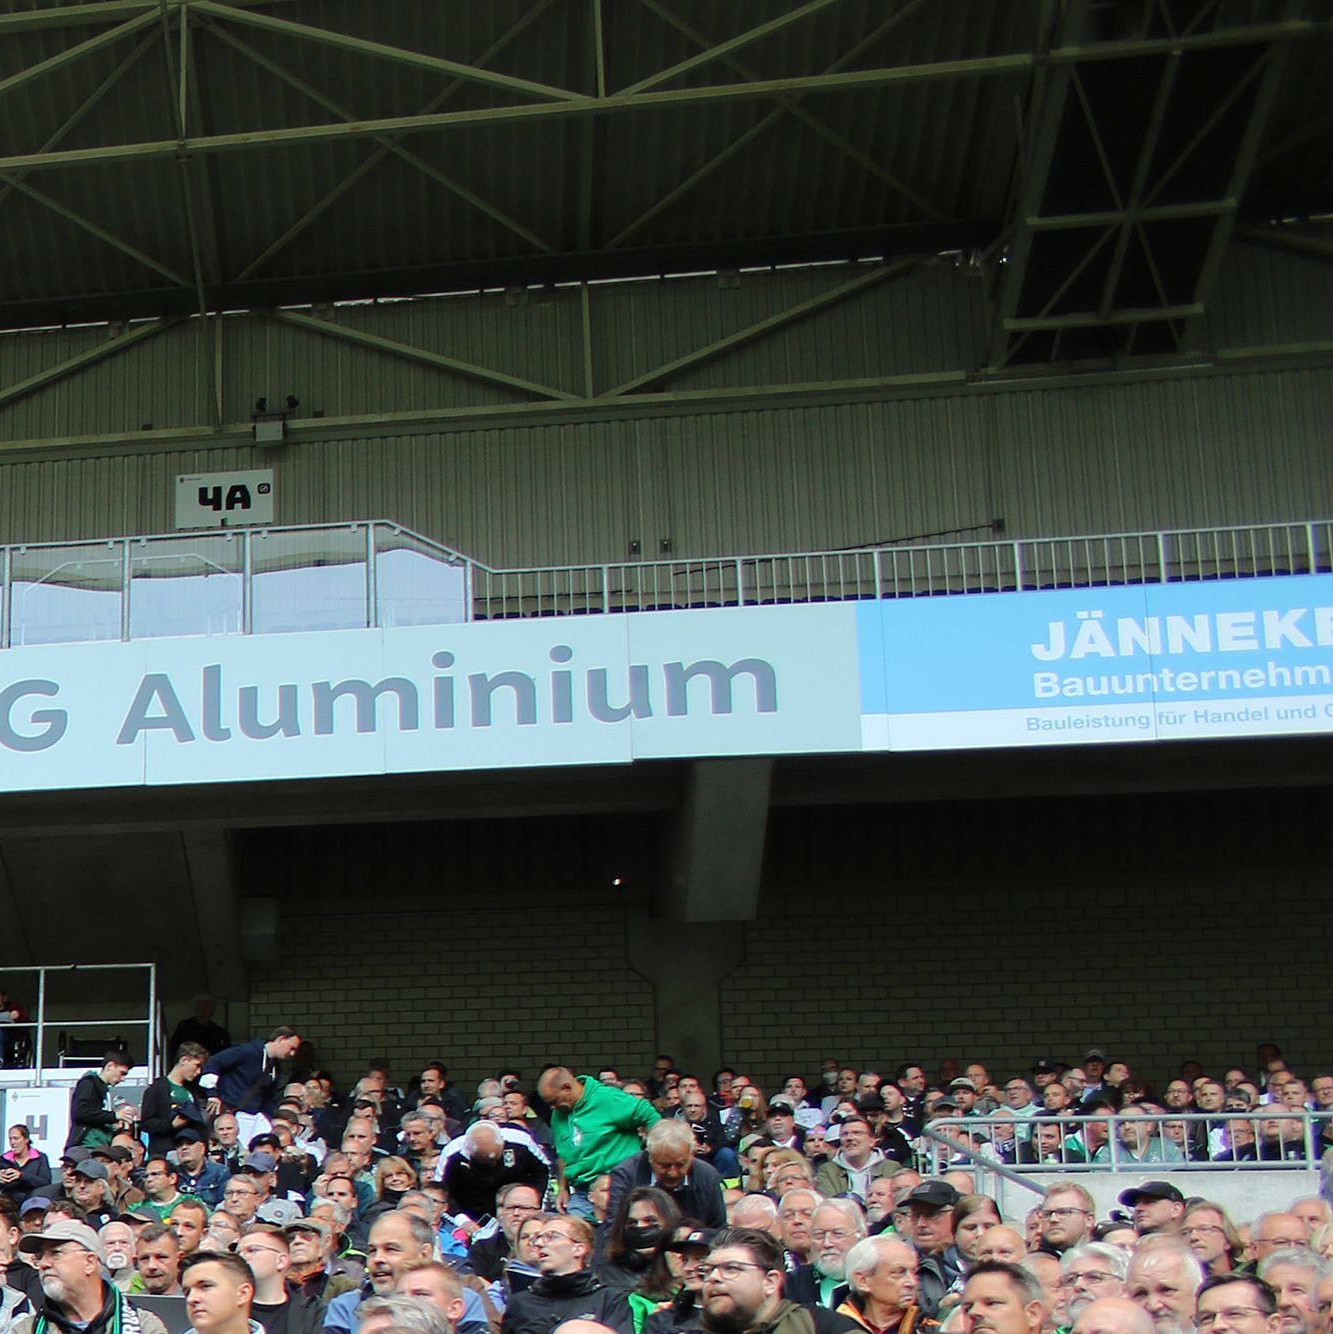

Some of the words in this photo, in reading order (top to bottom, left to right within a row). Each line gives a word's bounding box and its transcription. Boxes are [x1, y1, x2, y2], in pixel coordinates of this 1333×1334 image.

[198, 484, 251, 511] 4A
[116, 643, 778, 746] Aluminium
[1026, 713, 1150, 731] Bauleistung
[1157, 710, 1186, 726] für
[1193, 706, 1269, 724] Handel
[1276, 703, 1317, 721] und
